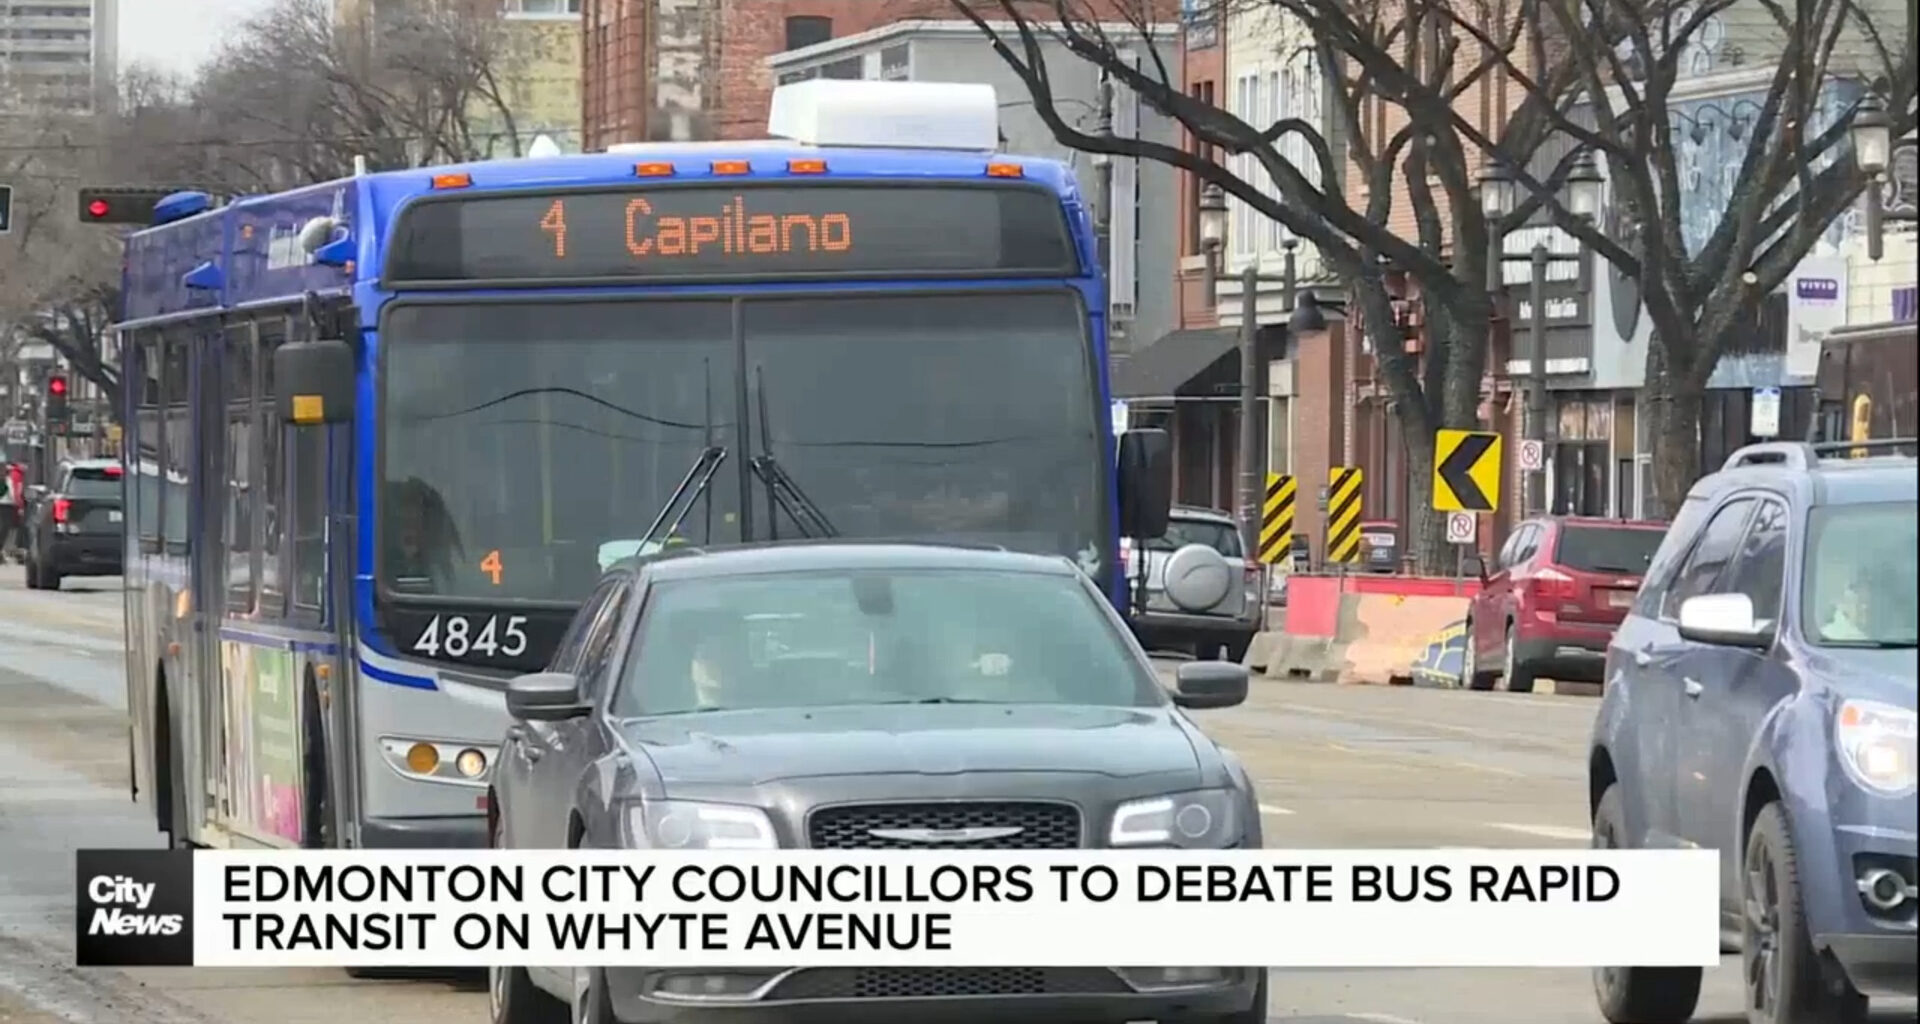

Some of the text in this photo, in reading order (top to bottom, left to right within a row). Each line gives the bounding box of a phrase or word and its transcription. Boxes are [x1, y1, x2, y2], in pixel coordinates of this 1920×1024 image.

[541, 196, 852, 258] 4 Capilano
[1799, 280, 1837, 291] VIVID
[480, 549, 503, 585] 4
[414, 614, 528, 657] 4845
